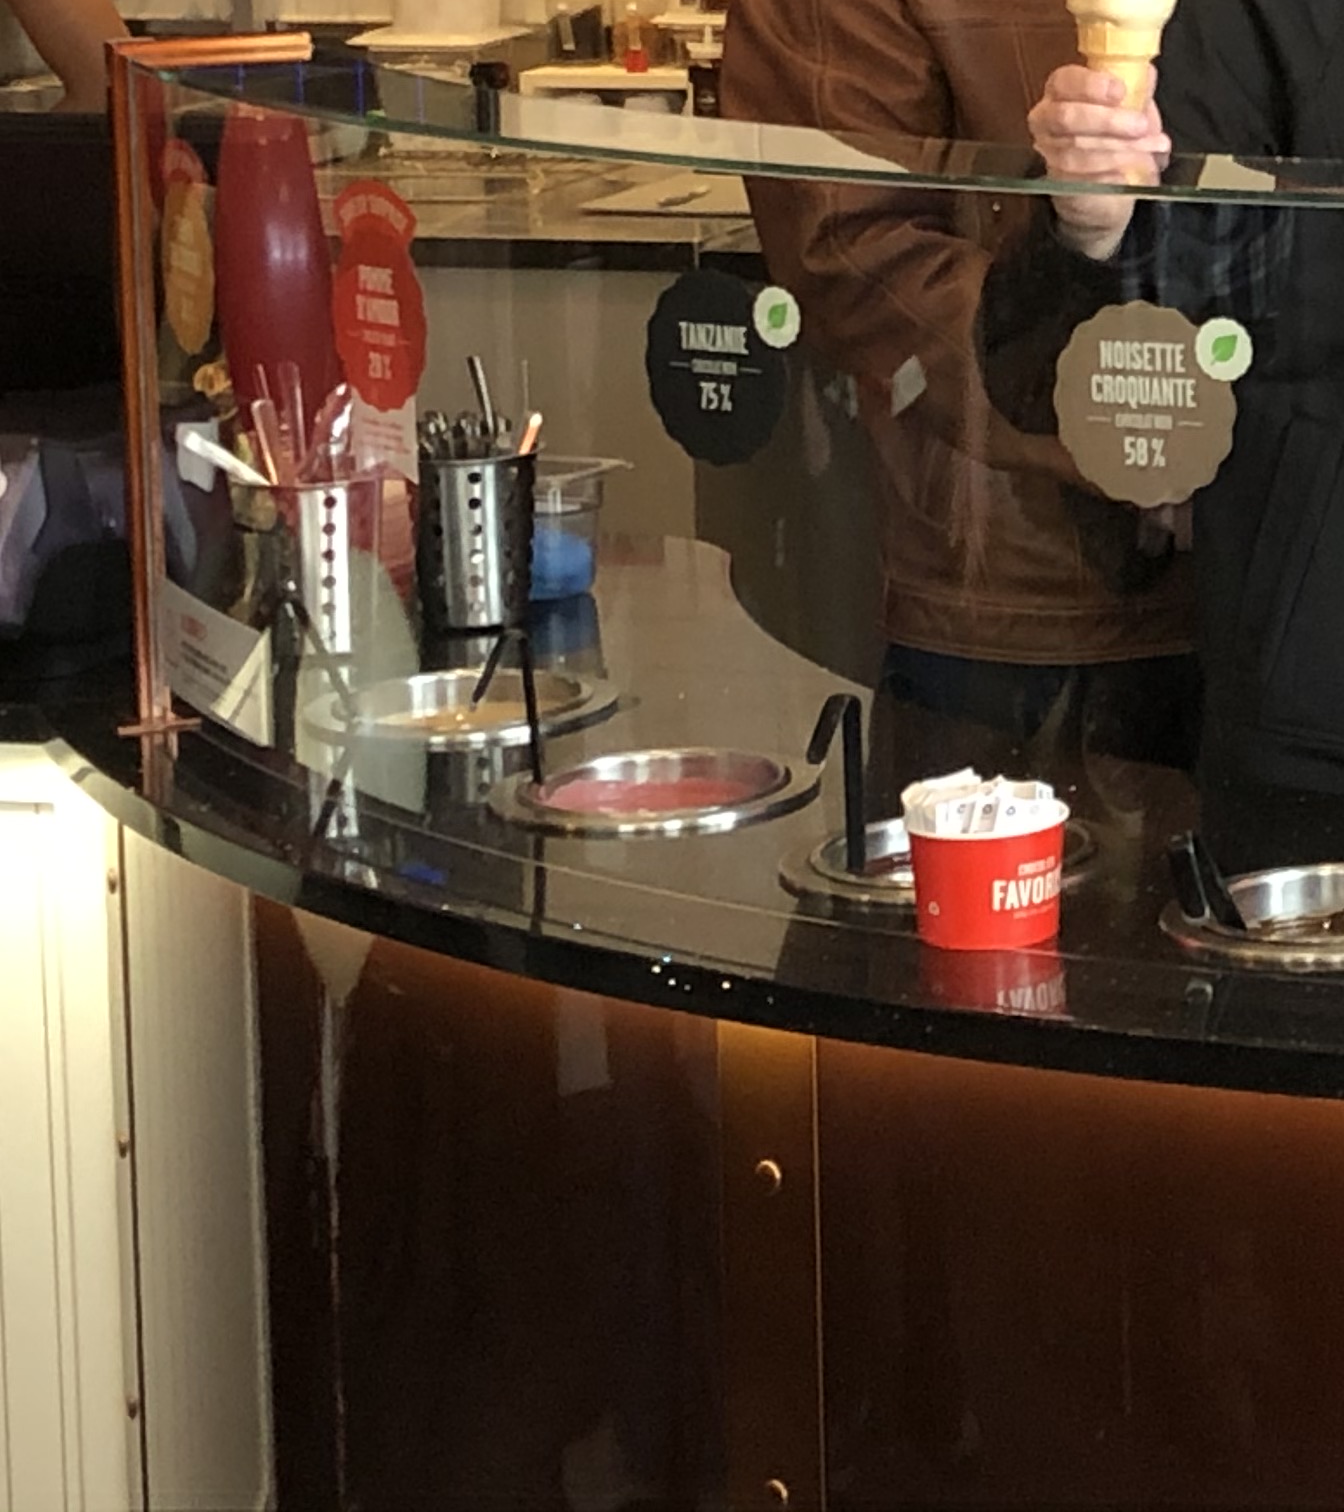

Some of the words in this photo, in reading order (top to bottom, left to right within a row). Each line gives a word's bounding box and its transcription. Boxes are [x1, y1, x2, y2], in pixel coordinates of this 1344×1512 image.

[678, 321, 749, 355] TANZANIE
[1100, 340, 1186, 373] NOISETTE
[1091, 374, 1197, 409] CROQUANTE
